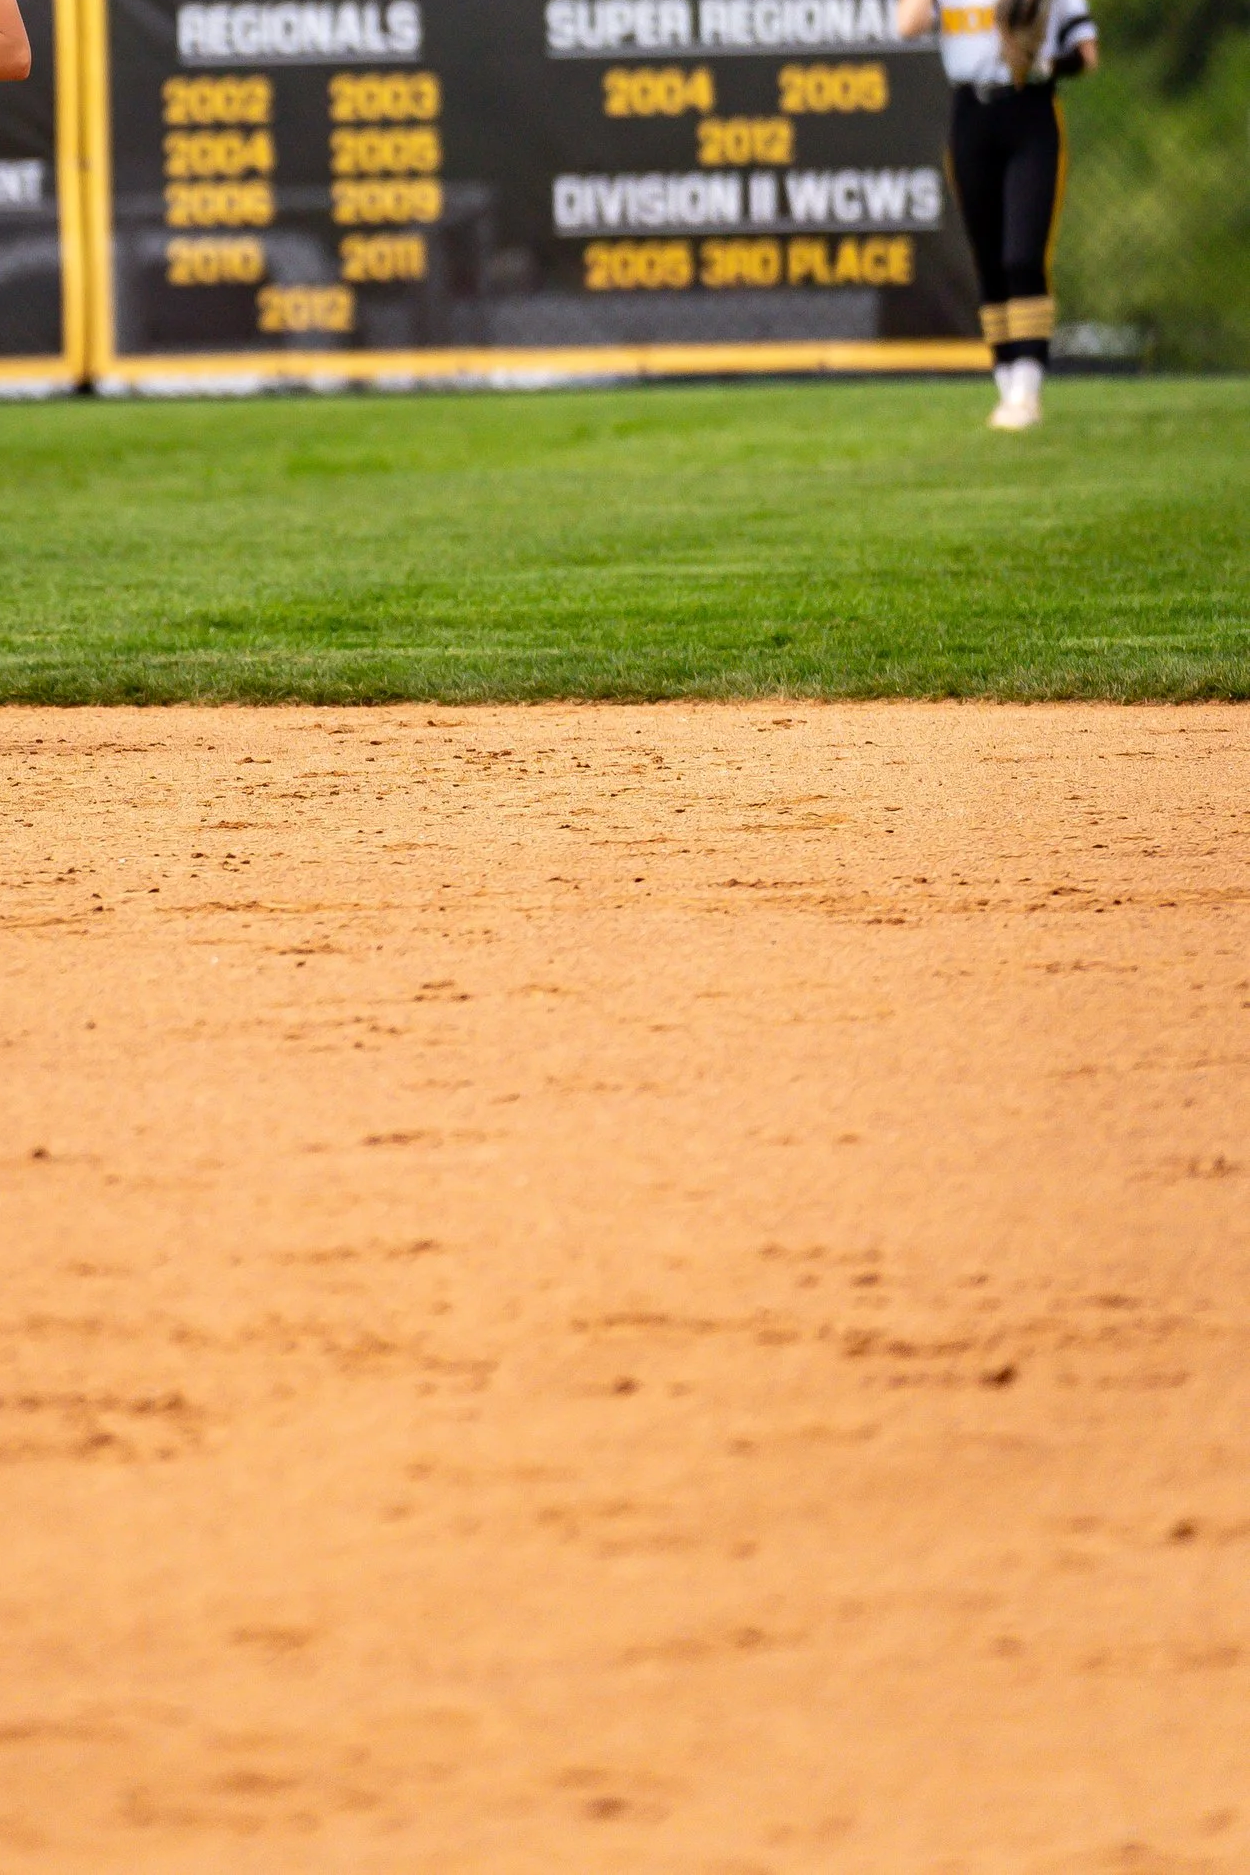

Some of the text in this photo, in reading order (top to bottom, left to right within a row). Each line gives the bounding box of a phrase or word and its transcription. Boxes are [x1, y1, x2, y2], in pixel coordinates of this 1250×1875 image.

[177, 0, 422, 57] REGIONALS
[164, 74, 439, 124] 2002 2003
[605, 66, 887, 115] 2004 2005
[166, 132, 273, 177] 2004
[698, 119, 793, 164] 2012
[554, 171, 940, 224] DIVISION II WCWS
[165, 235, 425, 284] 2010 2011
[586, 240, 910, 289] 2005 3RD PLACE
[258, 285, 354, 332] 2012
